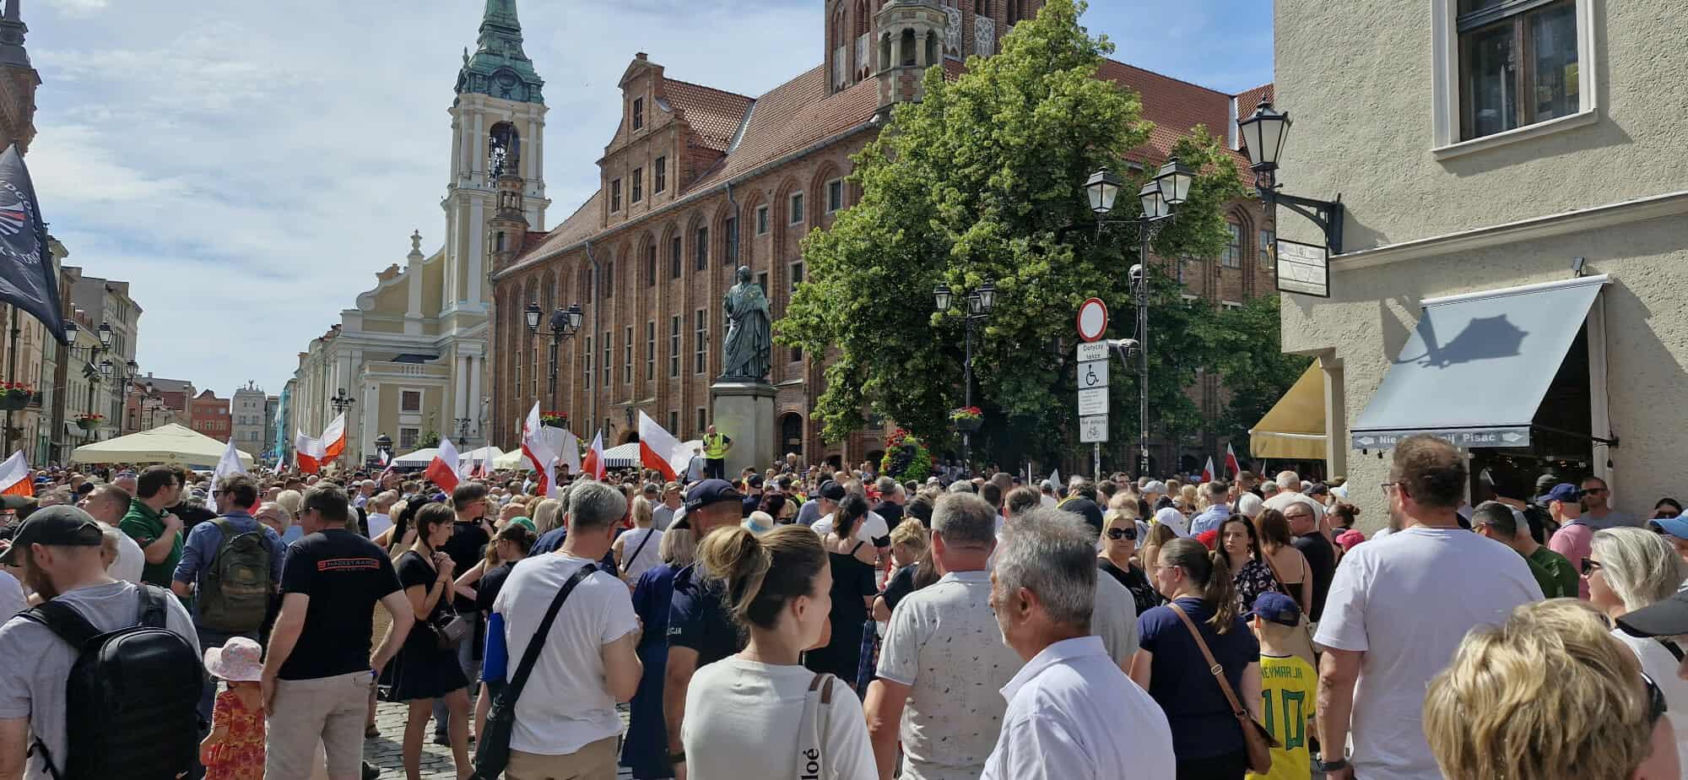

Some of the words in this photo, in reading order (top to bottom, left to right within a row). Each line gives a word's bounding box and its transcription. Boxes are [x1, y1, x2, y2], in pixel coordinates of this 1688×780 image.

[1379, 436, 1397, 445] Nie
[1462, 432, 1496, 442] Pisać
[1261, 688, 1306, 752] 10
